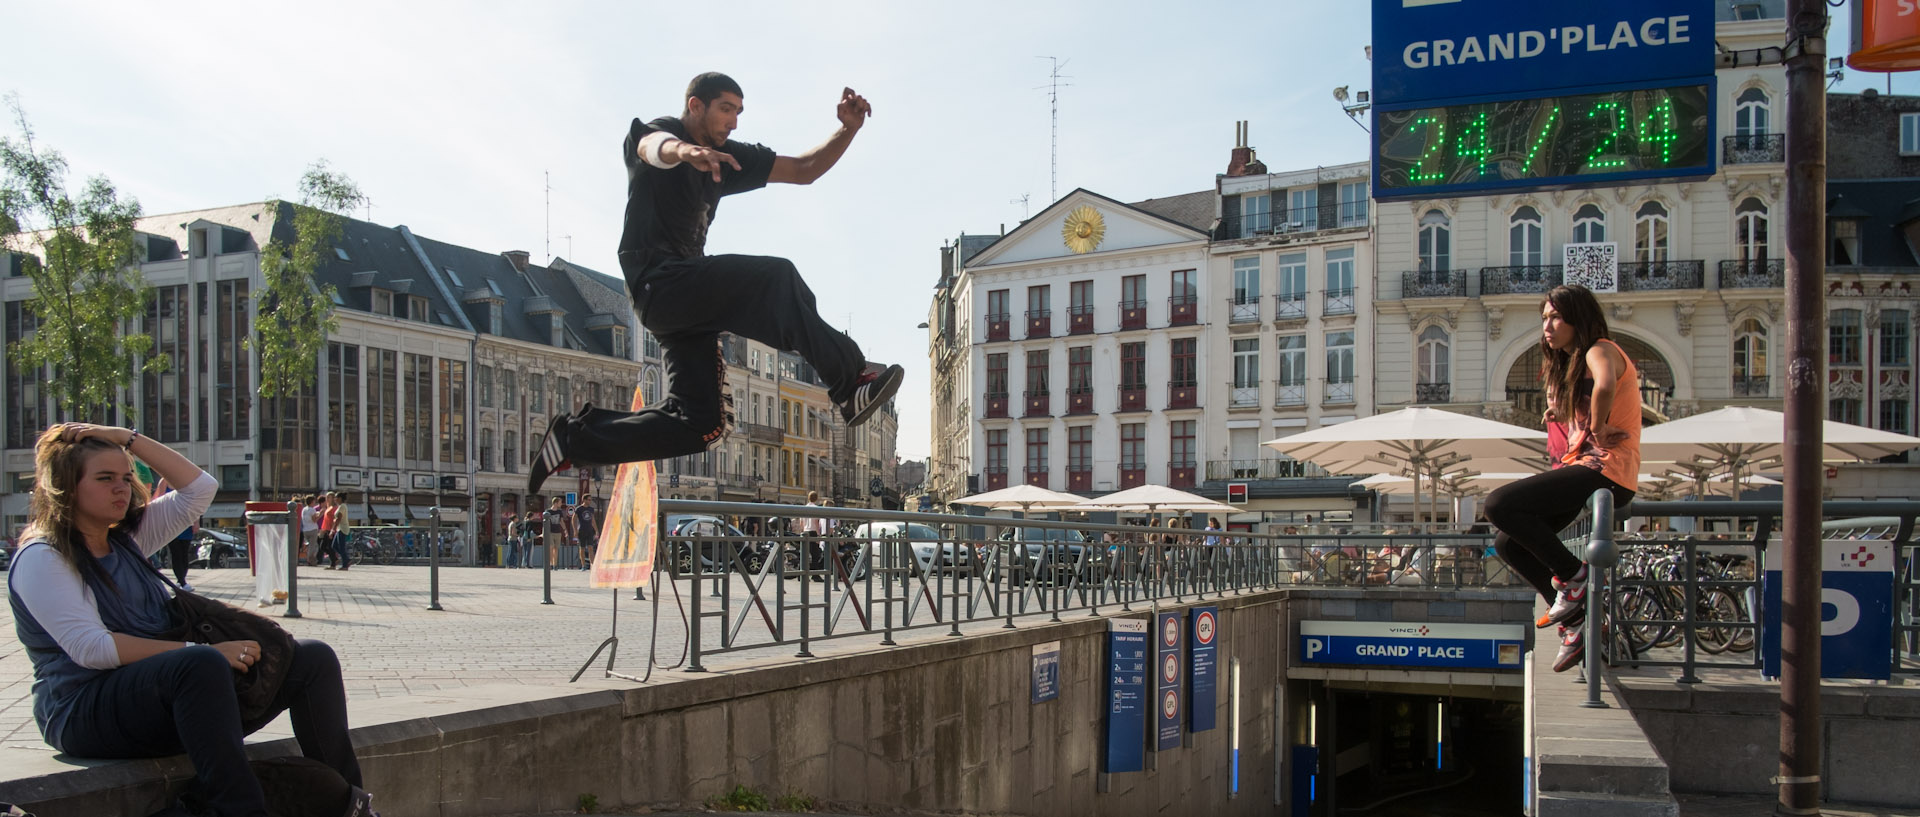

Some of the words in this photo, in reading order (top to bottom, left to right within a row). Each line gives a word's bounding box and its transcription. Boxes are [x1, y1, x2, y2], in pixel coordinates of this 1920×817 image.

[1402, 14, 1690, 69] GRAND'PLACE
[1200, 623, 1211, 633] GPL
[1306, 638, 1323, 659] P
[1355, 644, 1414, 657] GRAND'
[1417, 646, 1465, 659] PLACE
[1166, 699, 1175, 709] GPL
